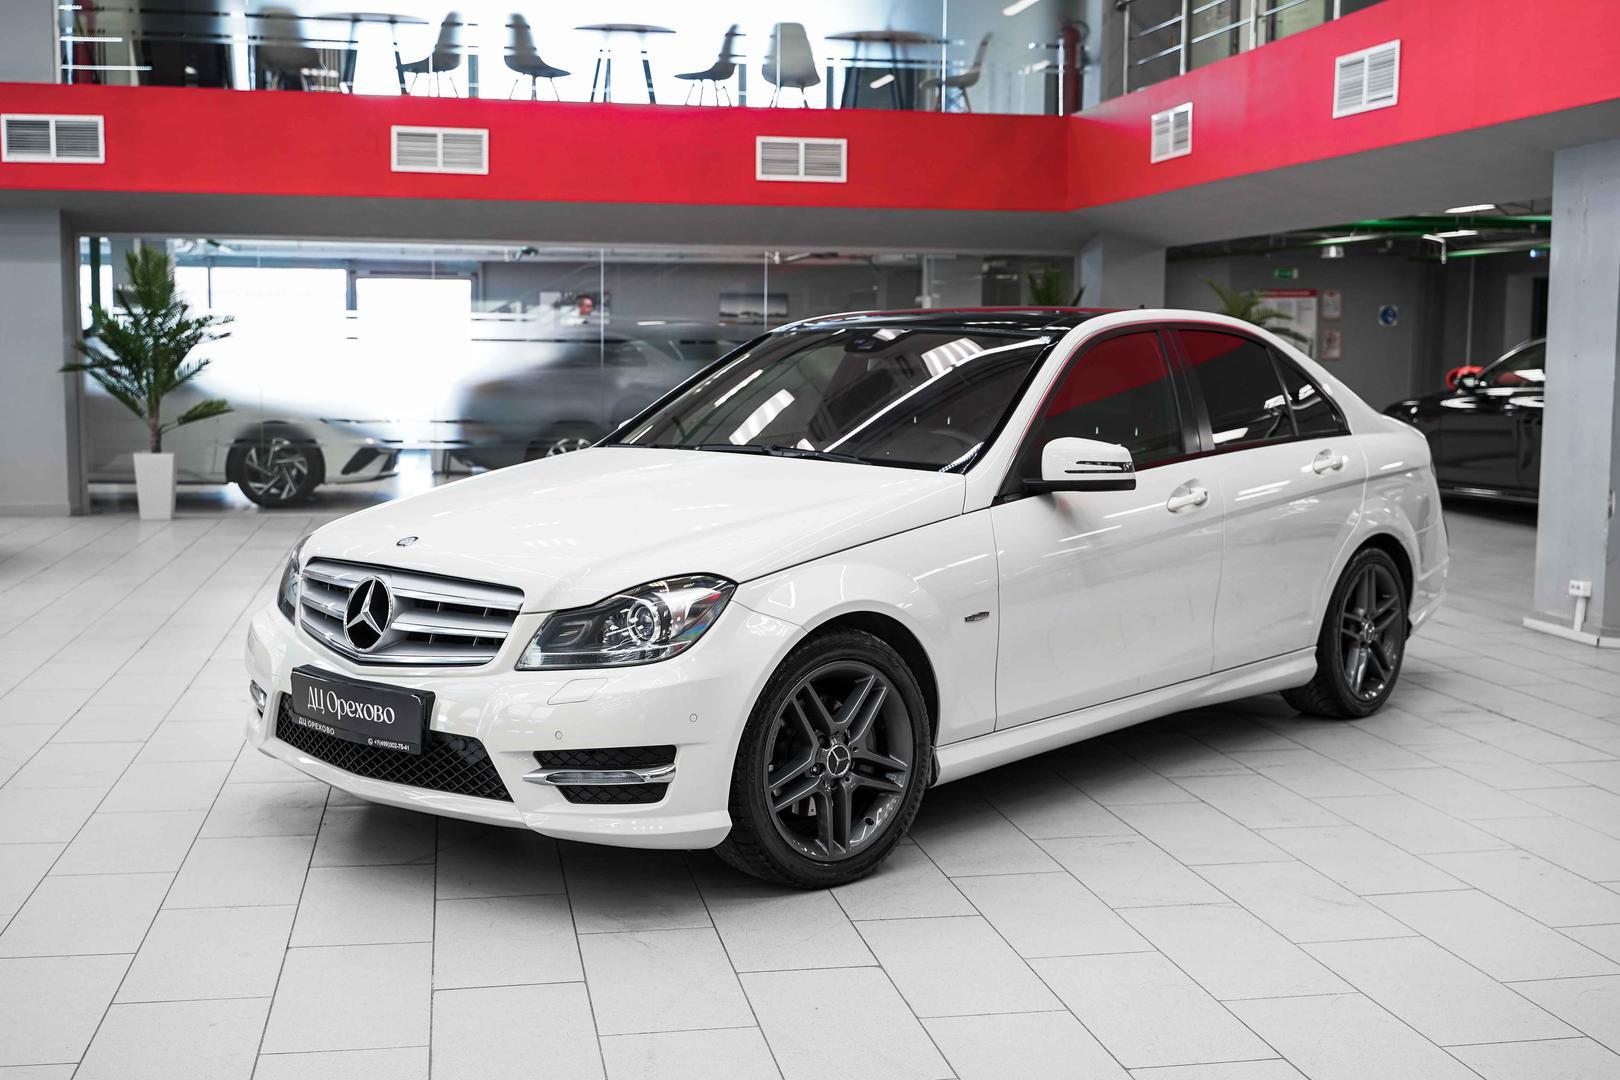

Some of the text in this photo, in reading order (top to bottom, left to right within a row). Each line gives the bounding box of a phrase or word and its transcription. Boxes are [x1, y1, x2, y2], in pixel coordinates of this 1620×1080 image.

[307, 686, 395, 724] ДЦ Орехово
[298, 717, 335, 735] ДЦ ОРЕХОВО
